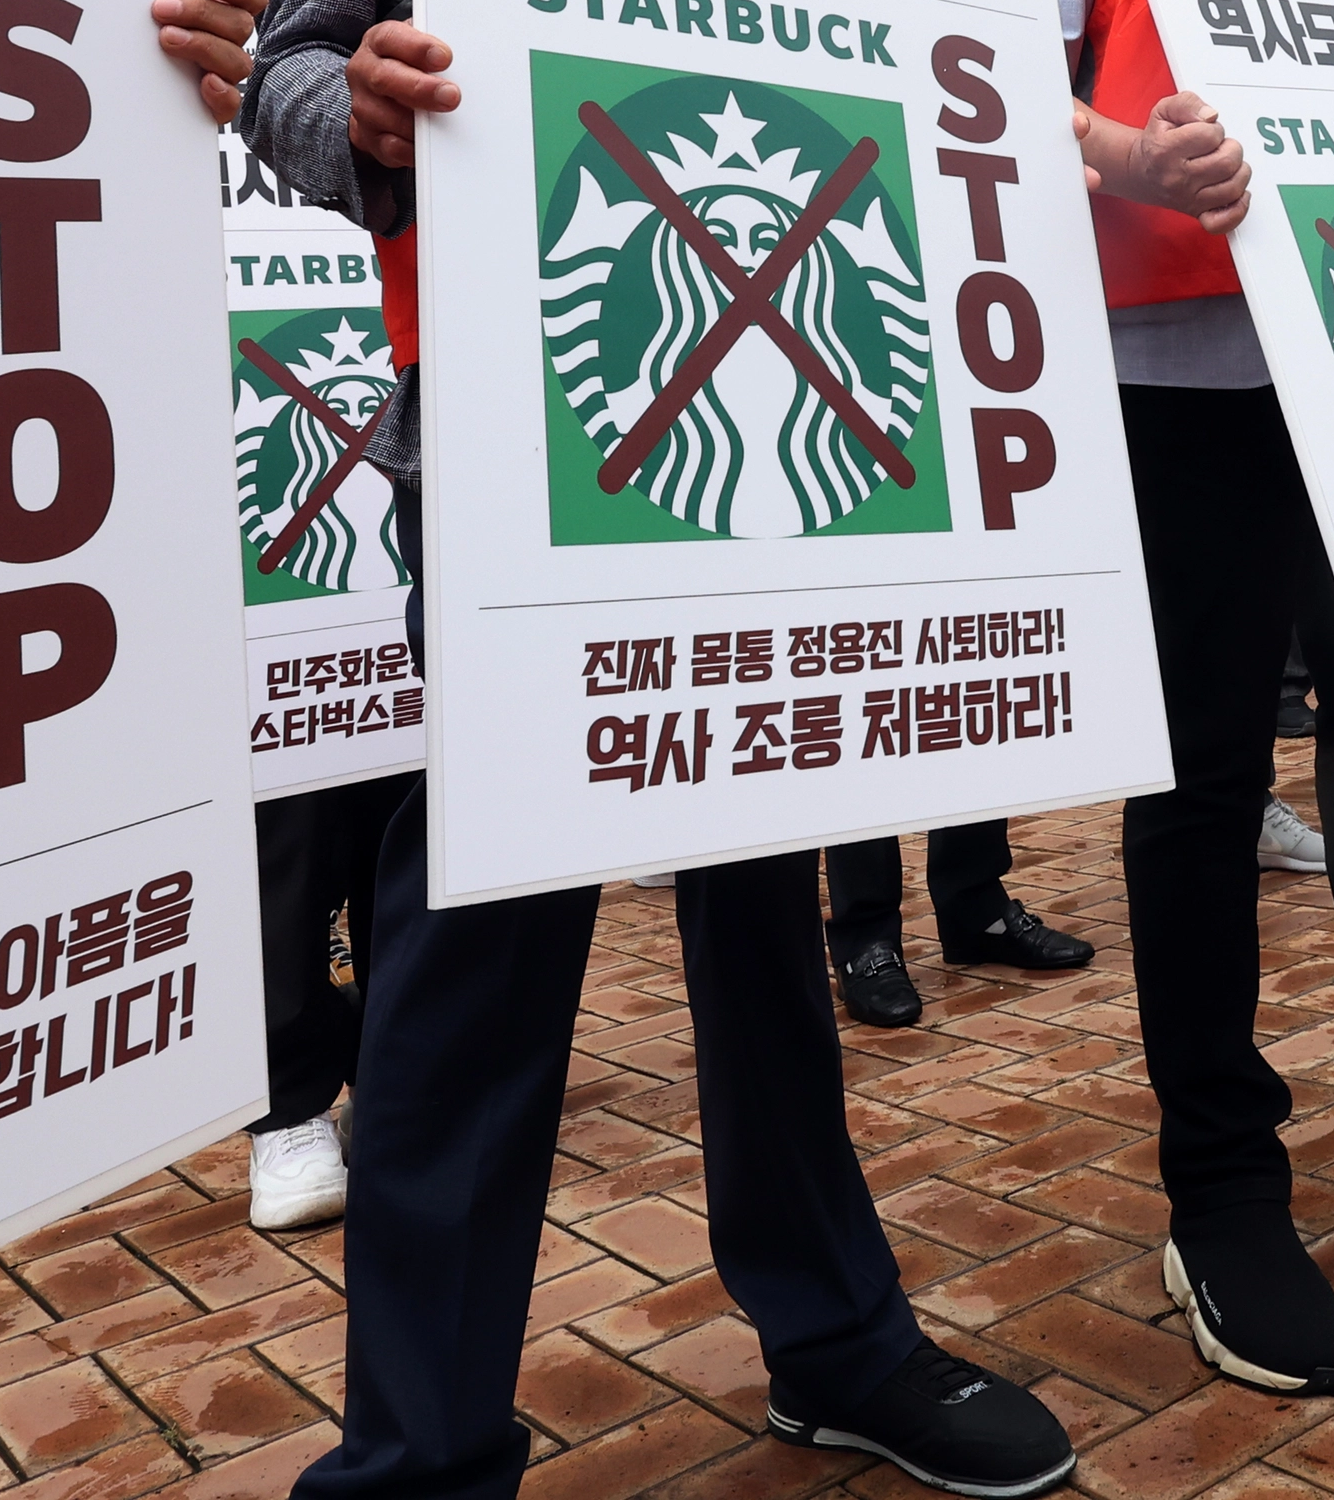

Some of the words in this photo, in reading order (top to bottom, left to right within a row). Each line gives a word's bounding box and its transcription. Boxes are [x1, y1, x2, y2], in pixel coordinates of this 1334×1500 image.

[226, 254, 383, 287] TARB
[930, 33, 1058, 532] STOP
[267, 642, 421, 702] 민주화운
[581, 635, 677, 698] 진짜
[690, 627, 775, 688] 몸통
[786, 619, 905, 679] 정용진
[915, 607, 1066, 666] 사퇴하라!
[250, 687, 426, 754] 스타벅스를
[586, 707, 714, 794] 역사
[731, 693, 845, 777] 조롱
[860, 670, 1073, 760] 처벌하라!
[959, 1380, 988, 1399] SPORT
